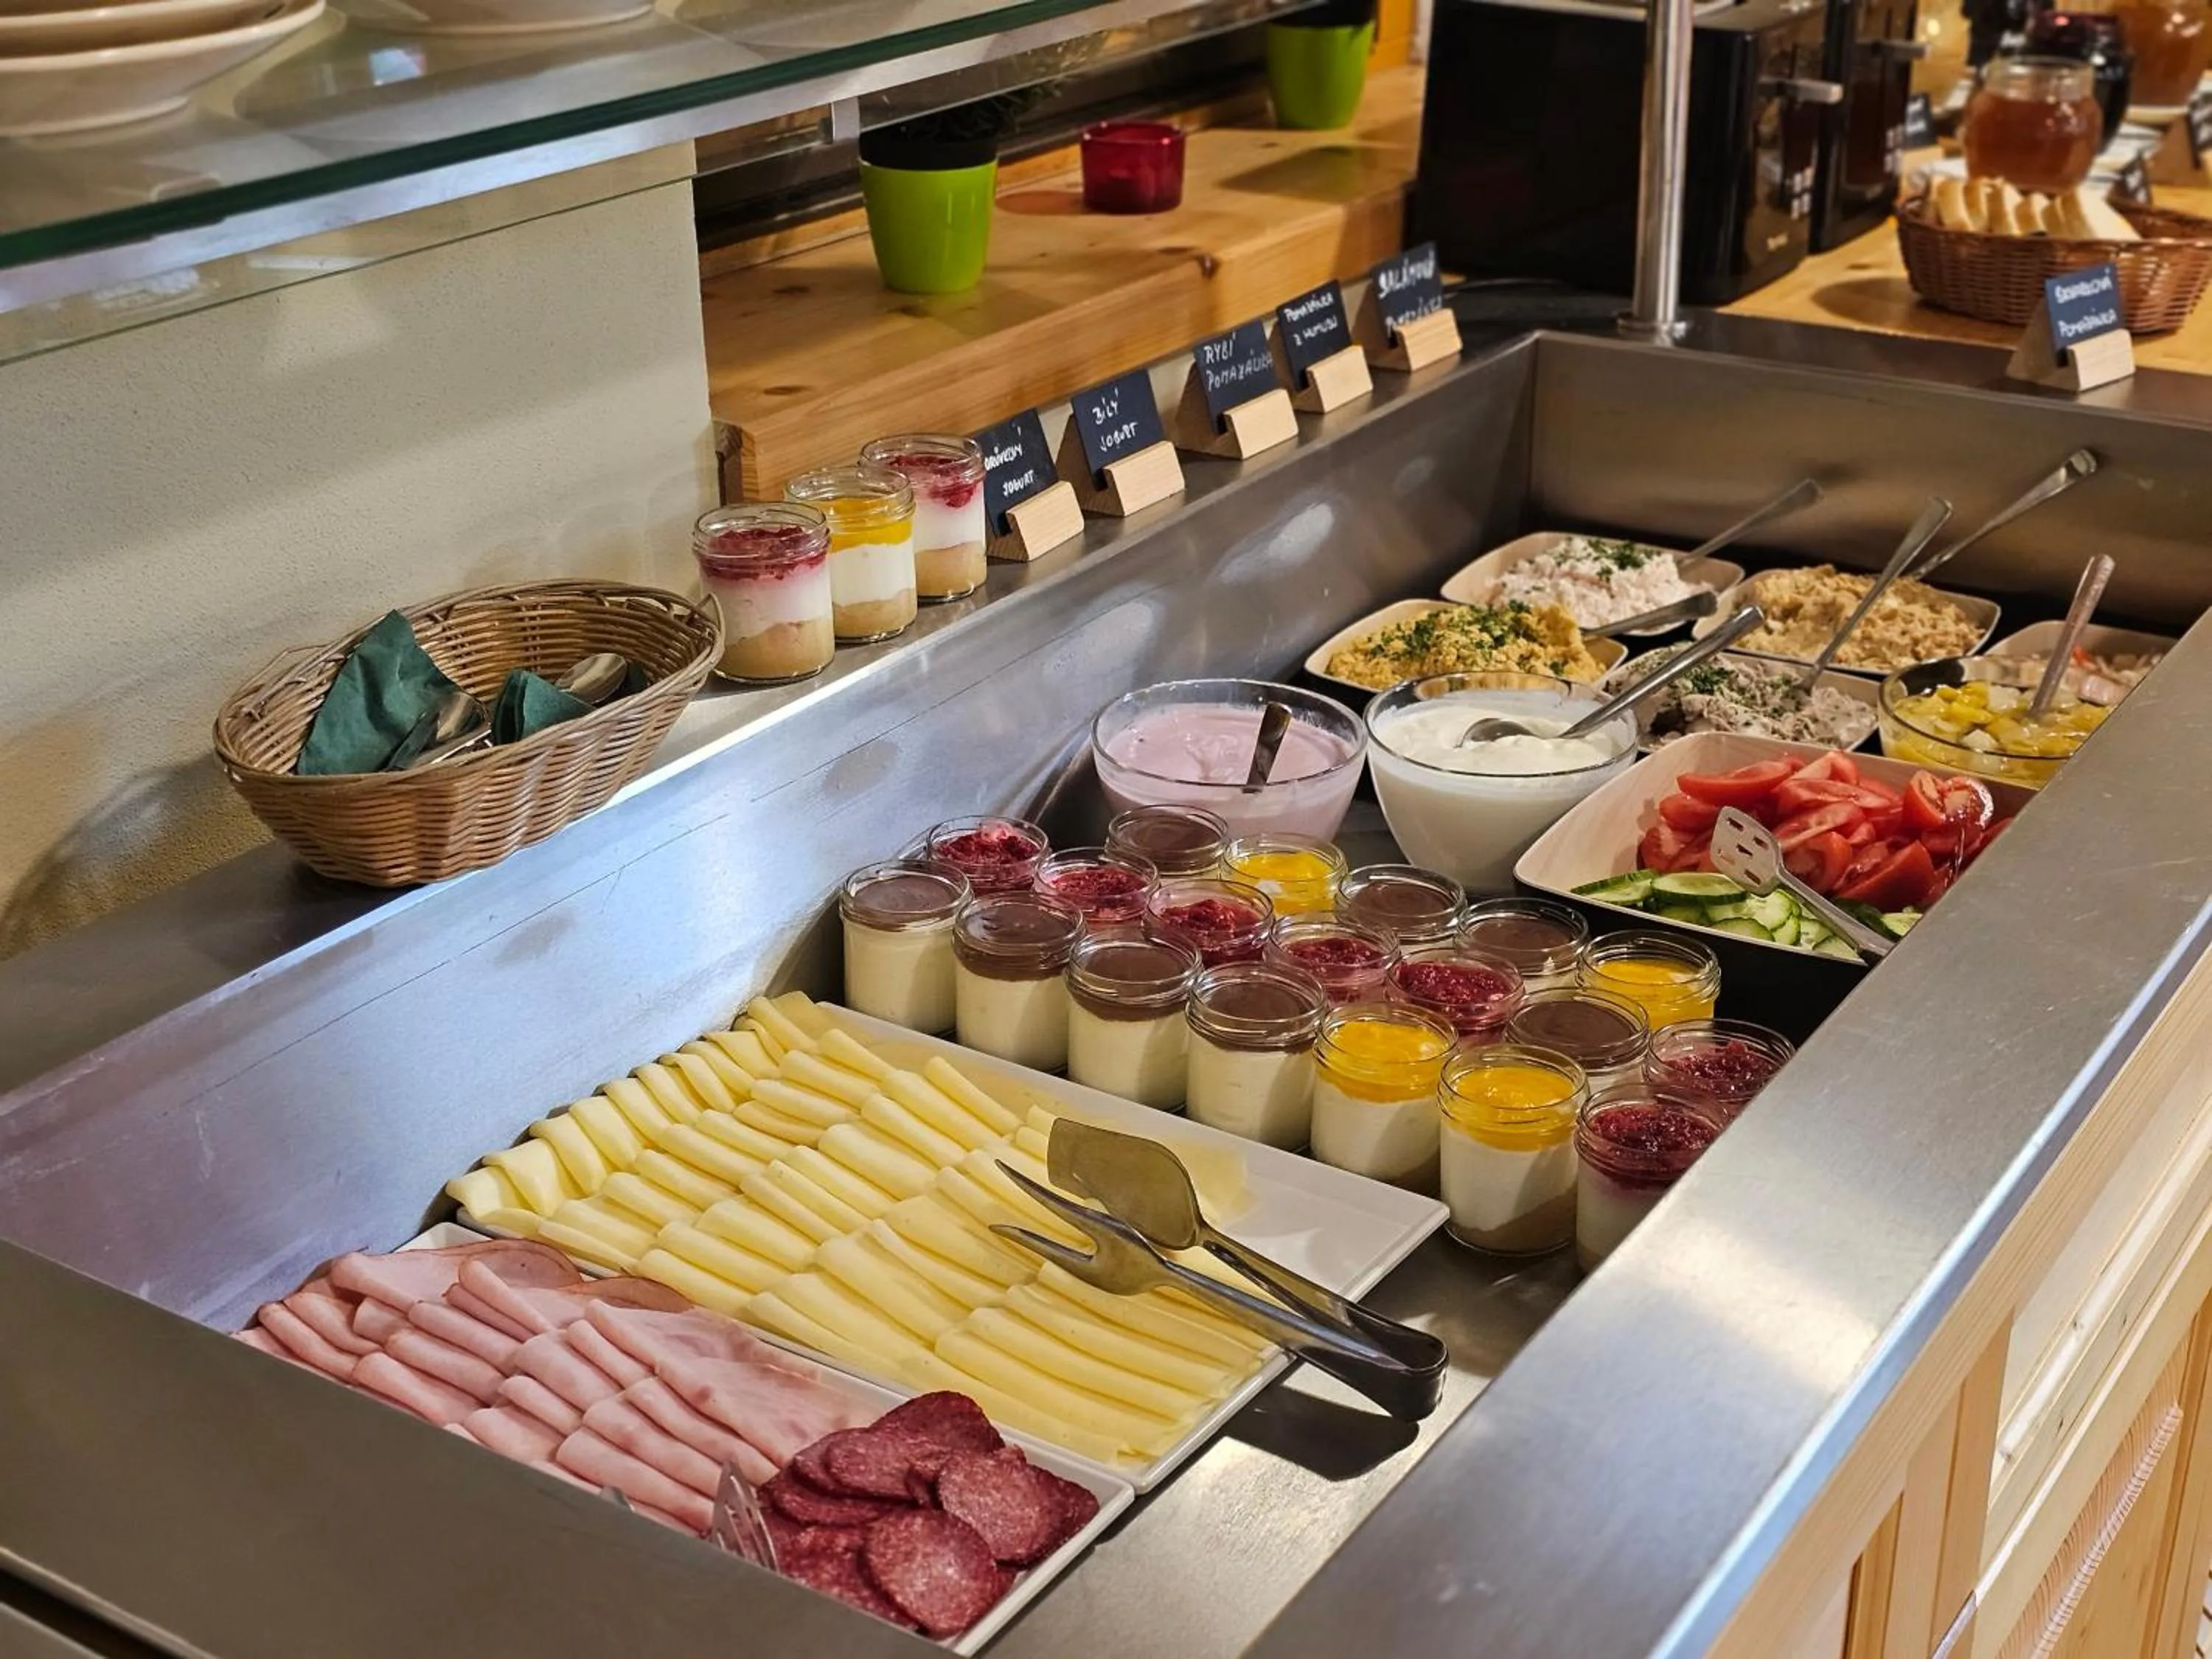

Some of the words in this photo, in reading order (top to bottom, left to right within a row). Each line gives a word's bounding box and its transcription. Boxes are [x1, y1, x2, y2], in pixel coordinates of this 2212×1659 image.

[1203, 331, 1237, 364] RYBÍ
[1092, 387, 1119, 425] BÍLÝ
[1100, 421, 1138, 452] JOGURT
[1003, 470, 1034, 497] JOGURT
